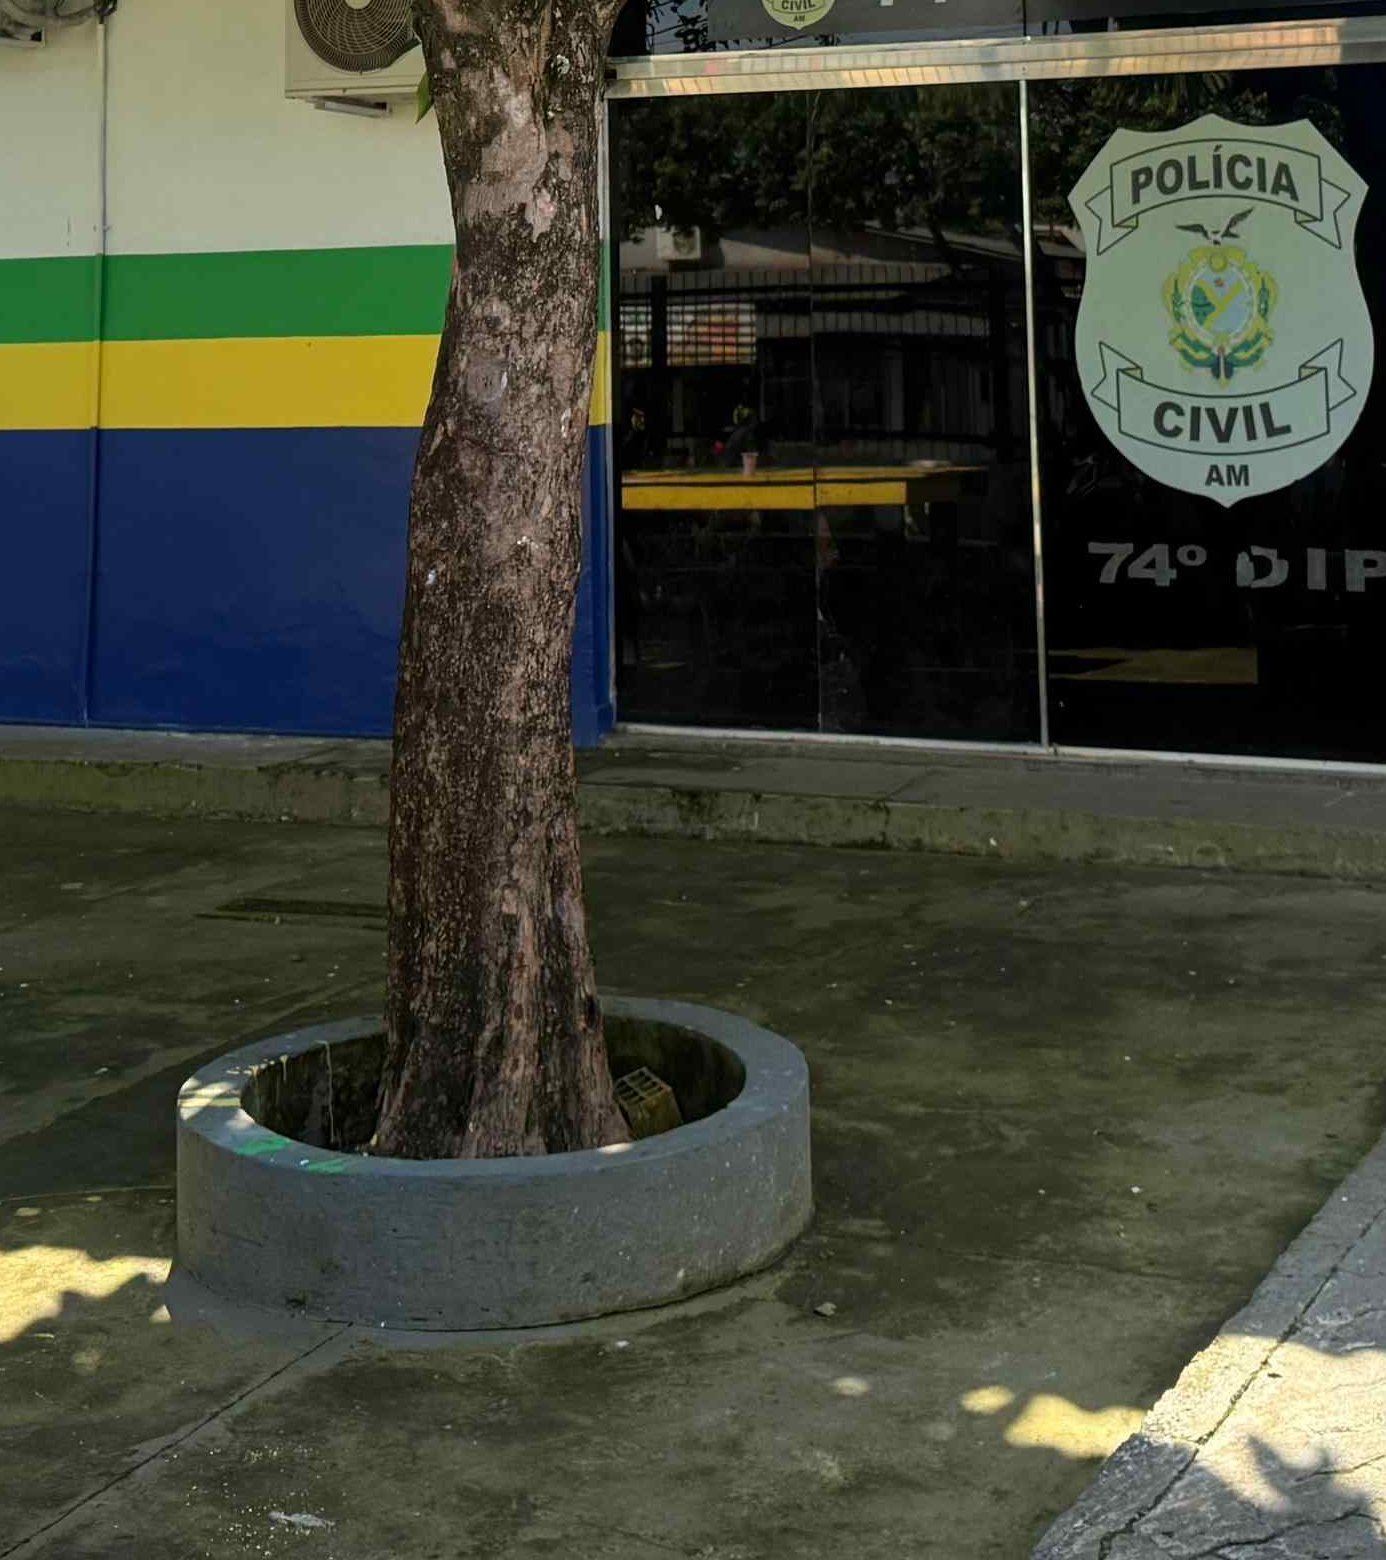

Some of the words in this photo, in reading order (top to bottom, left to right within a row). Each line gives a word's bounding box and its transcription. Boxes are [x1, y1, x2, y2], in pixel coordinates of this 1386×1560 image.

[1131, 144, 1300, 206] POLÍCIA
[1153, 401, 1293, 444] CIVIL
[1204, 463, 1251, 487] AM
[1087, 541, 1207, 587] 74º
